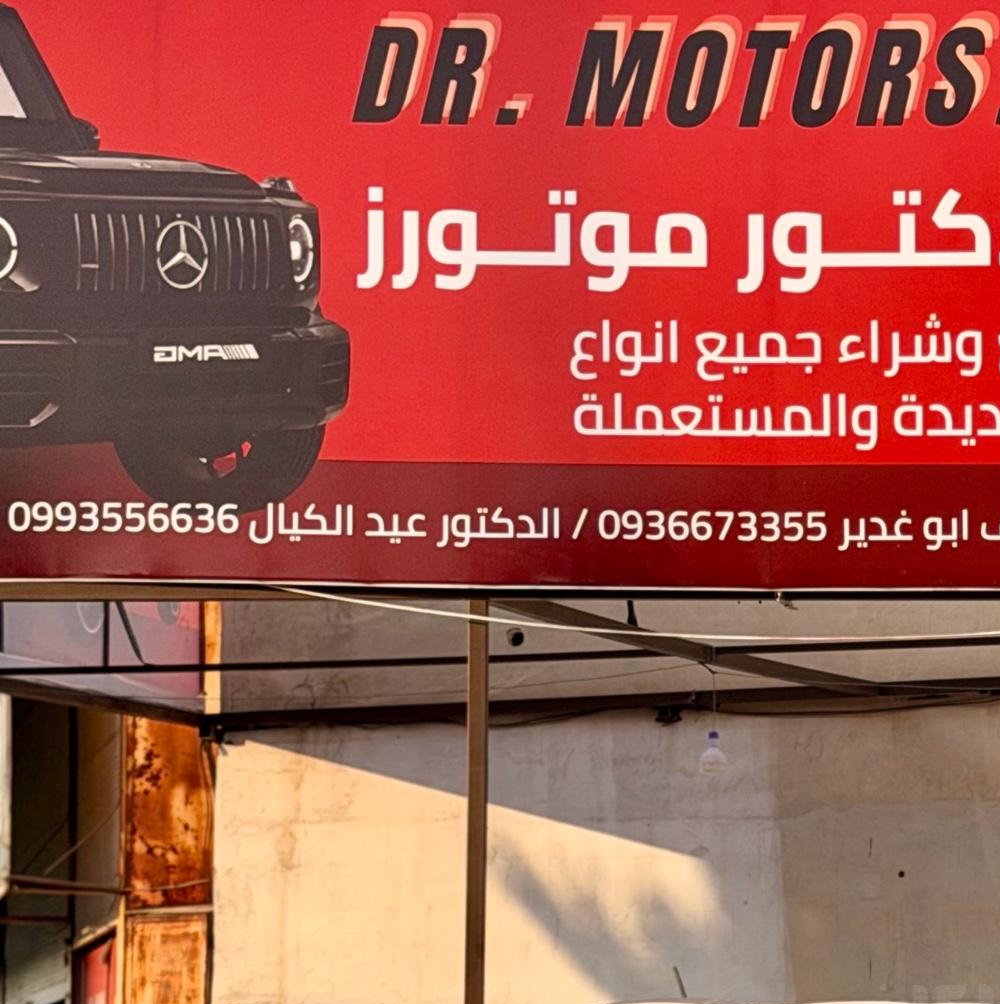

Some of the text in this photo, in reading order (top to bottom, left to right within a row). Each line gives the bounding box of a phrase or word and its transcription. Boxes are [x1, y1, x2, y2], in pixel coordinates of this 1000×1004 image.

[356, 186, 708, 293] موتورز
[569, 319, 678, 381] انواع
[695, 332, 822, 382] جميع
[838, 313, 983, 378] وشراء
[573, 392, 878, 451] والمستعملة
[8, 501, 240, 534] 0993556636
[248, 502, 354, 545] الكيال
[364, 512, 427, 544] عيد
[436, 506, 560, 548] الدكتور
[598, 509, 827, 542] 0936673355
[837, 509, 914, 551] غدير
[922, 508, 969, 551] ابو
